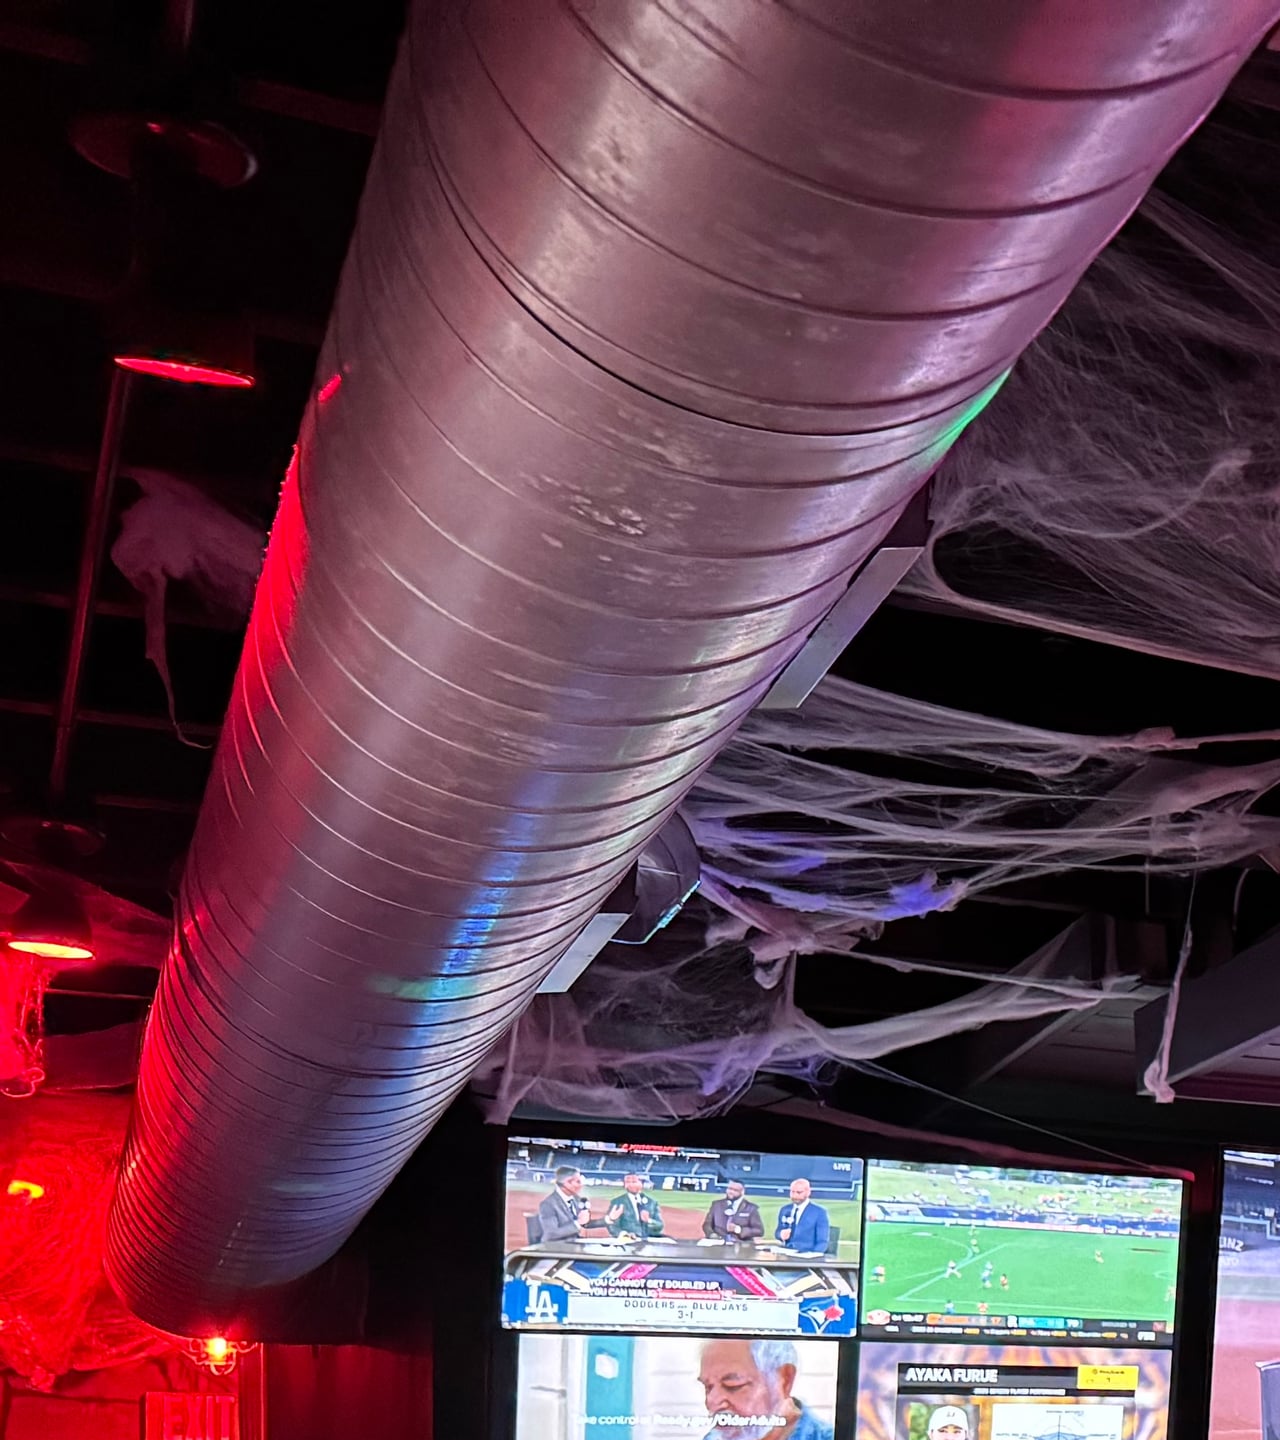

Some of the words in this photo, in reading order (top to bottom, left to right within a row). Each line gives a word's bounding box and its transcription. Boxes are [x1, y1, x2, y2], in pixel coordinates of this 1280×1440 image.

[721, 1303, 748, 1312] JAYS
[905, 1367, 952, 1382] AYAKA
[953, 1368, 998, 1383] FURUE
